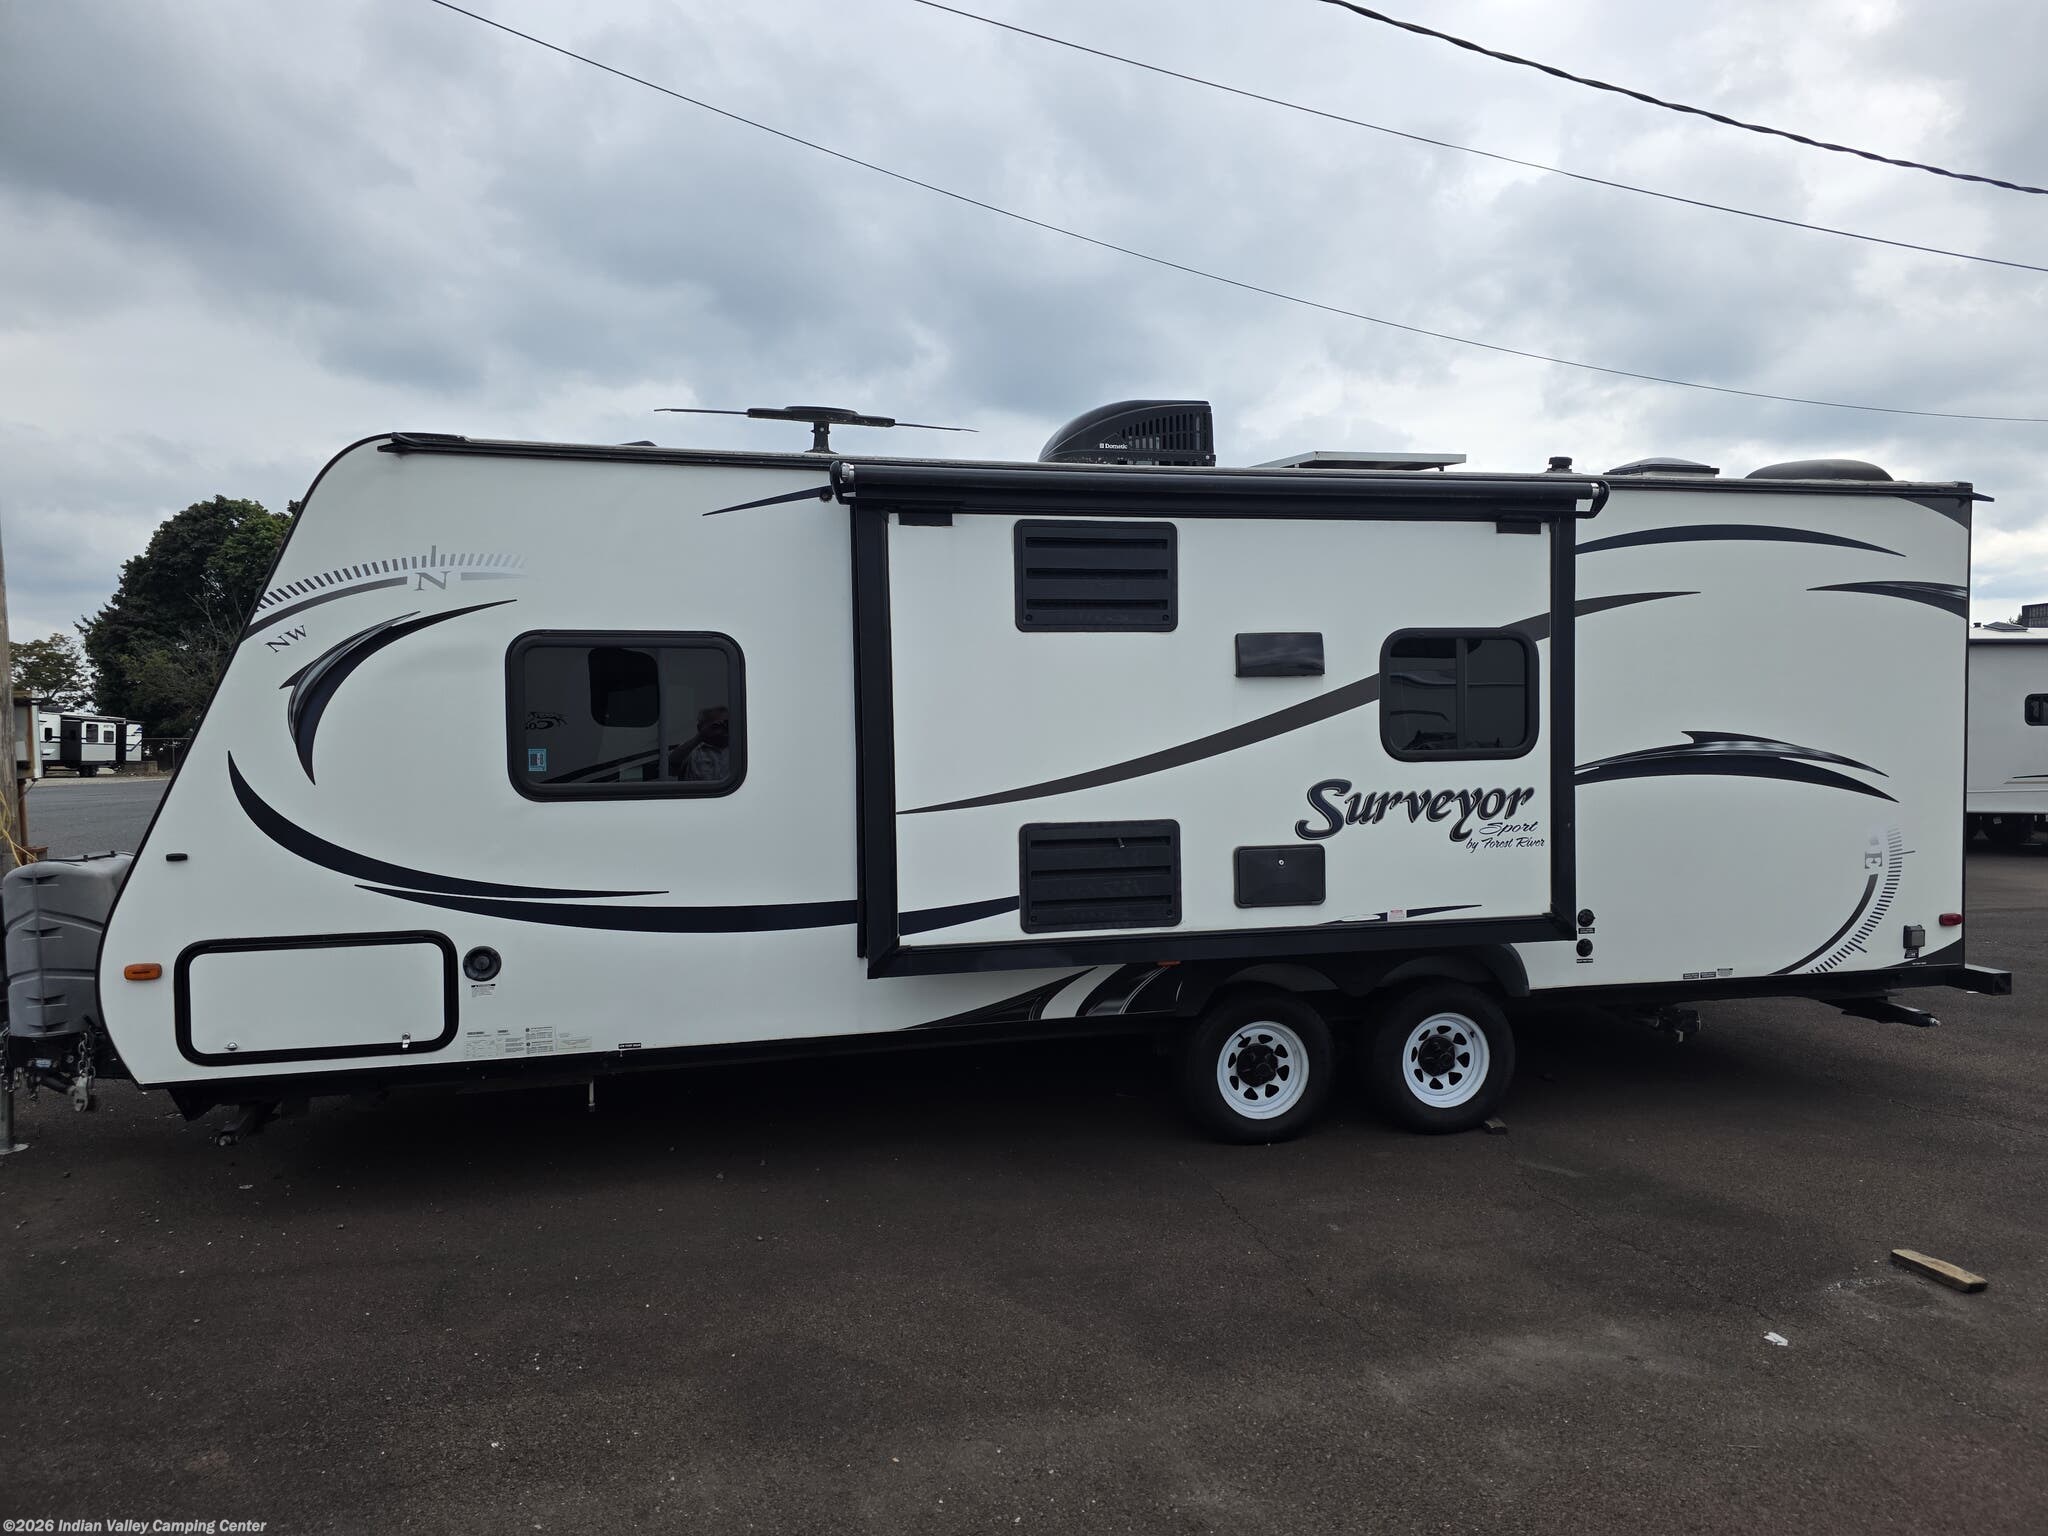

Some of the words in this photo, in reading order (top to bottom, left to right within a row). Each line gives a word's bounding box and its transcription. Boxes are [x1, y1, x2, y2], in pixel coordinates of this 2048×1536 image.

[414, 571, 450, 591] N
[265, 625, 307, 653] NW
[1295, 778, 1535, 842] Surveyor
[1479, 821, 1539, 836] Sport
[1466, 838, 1479, 853] by
[1481, 837, 1513, 848] Forest
[1516, 836, 1546, 848] River
